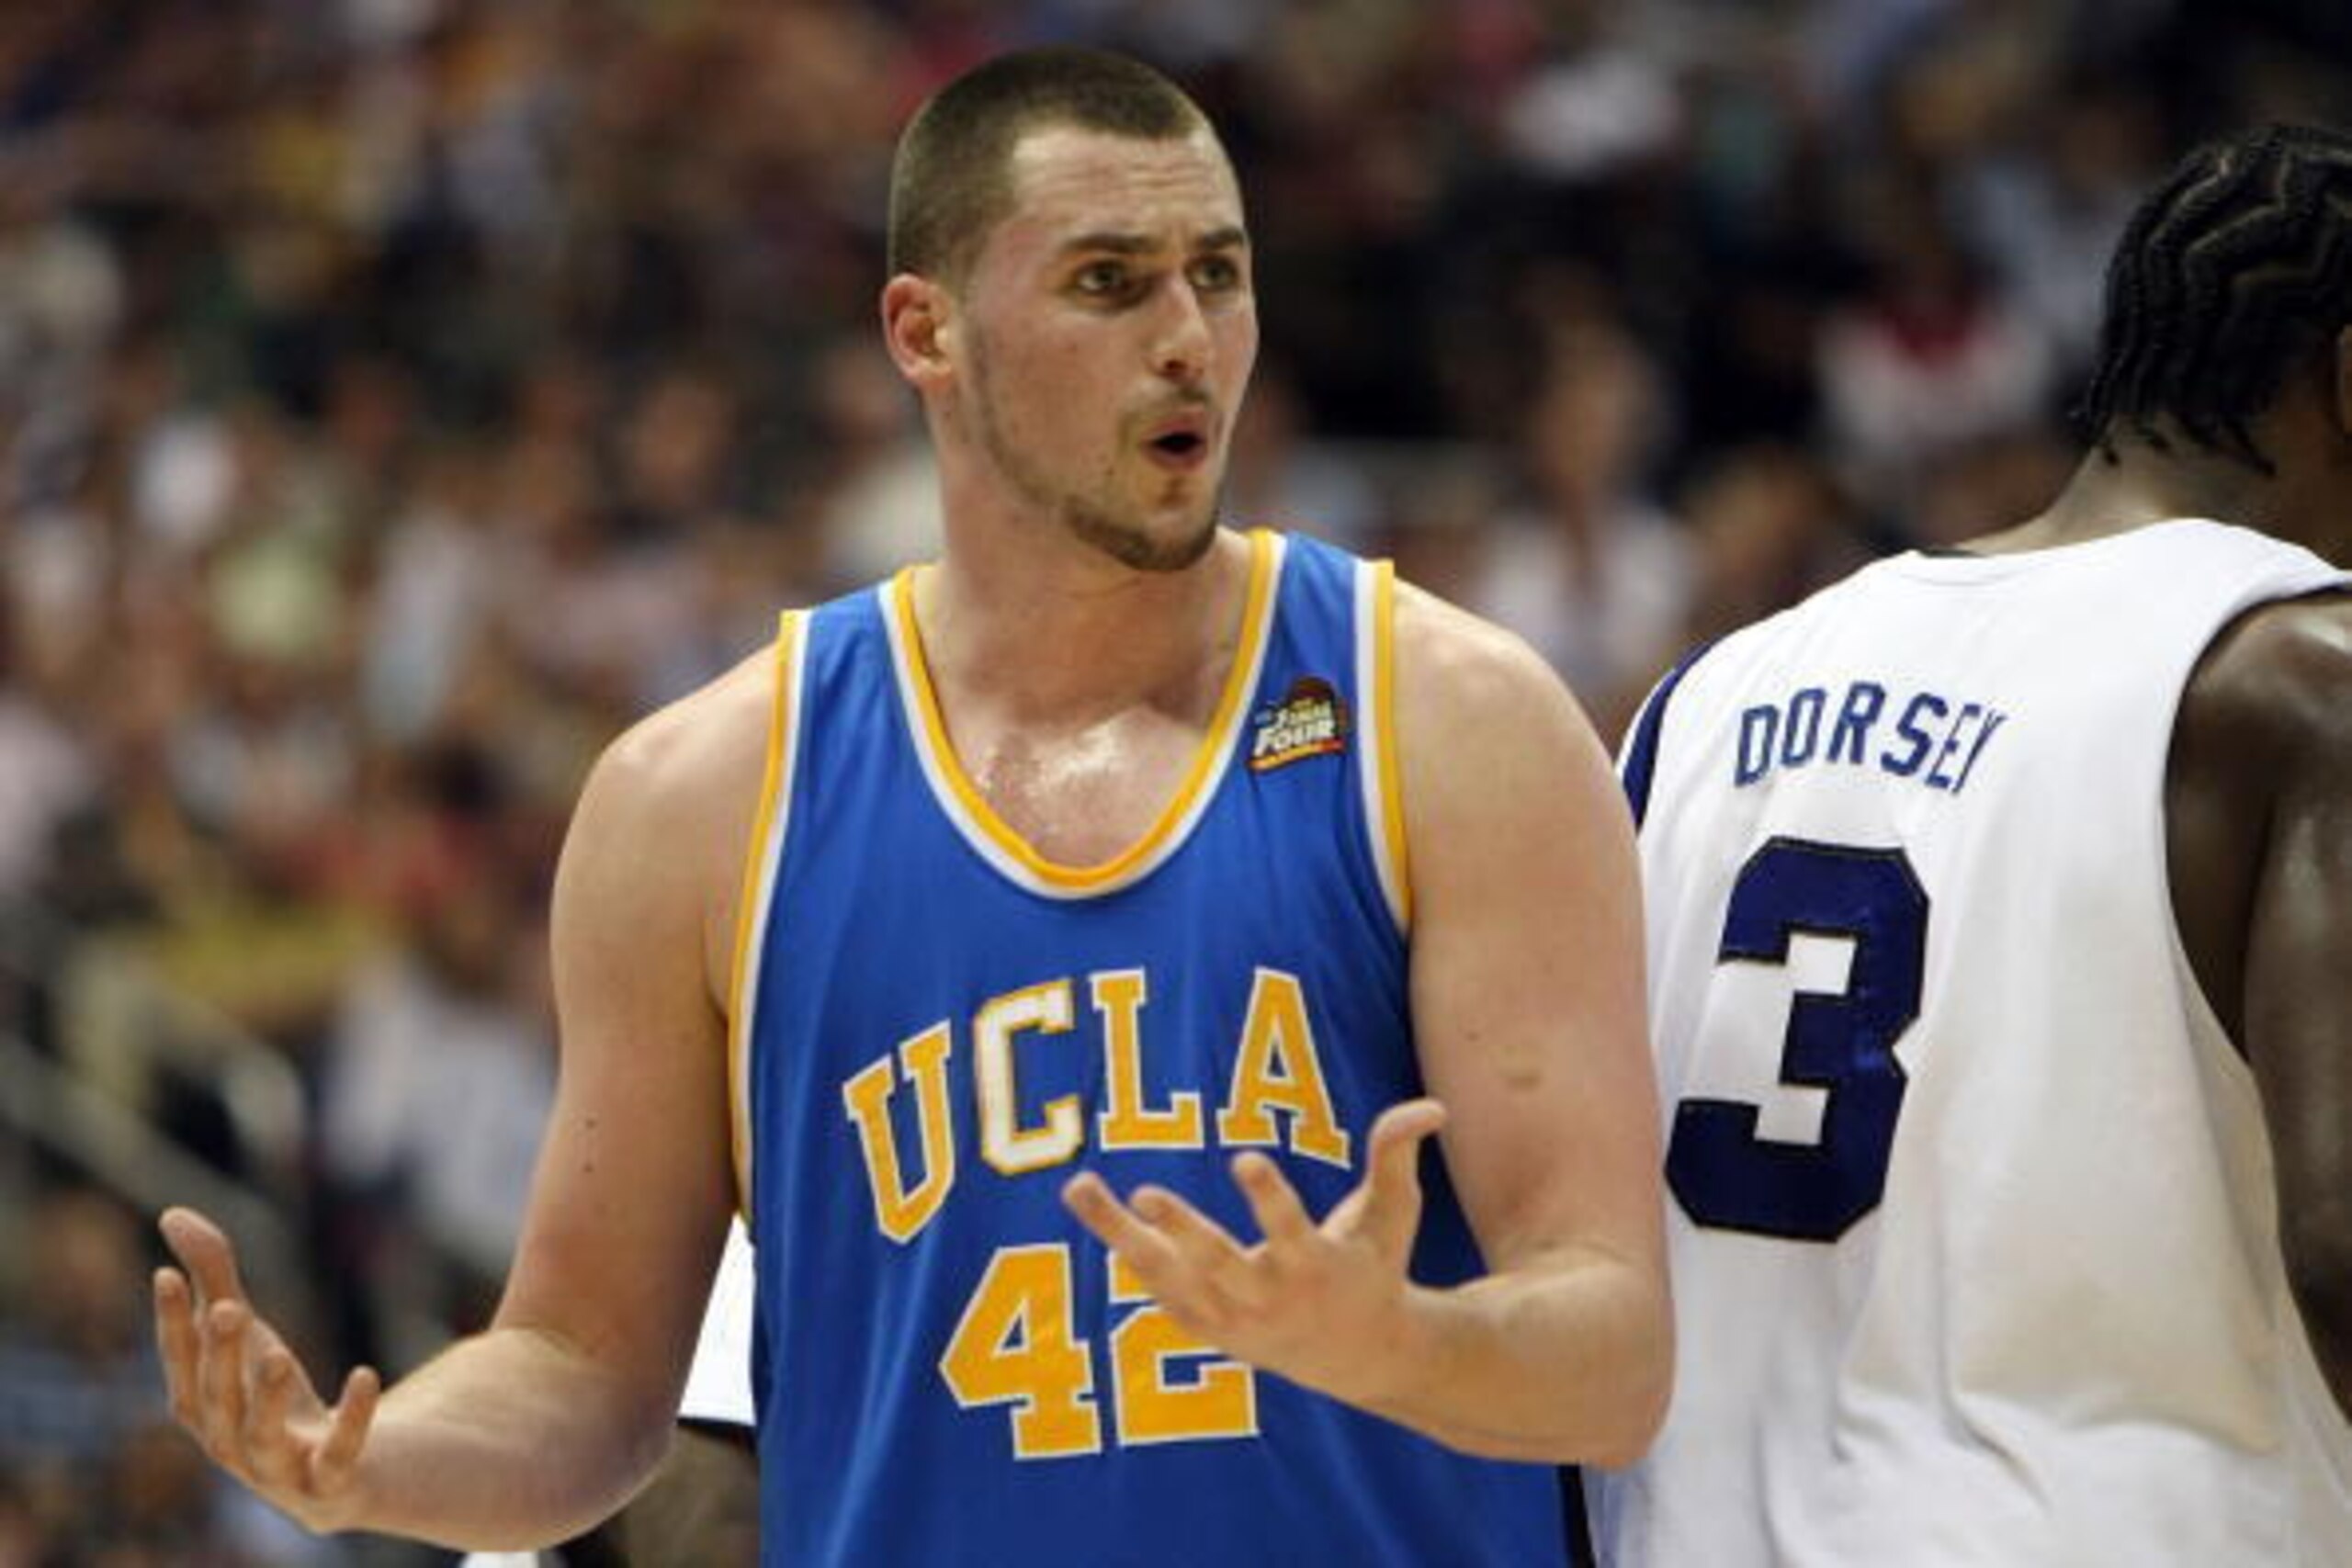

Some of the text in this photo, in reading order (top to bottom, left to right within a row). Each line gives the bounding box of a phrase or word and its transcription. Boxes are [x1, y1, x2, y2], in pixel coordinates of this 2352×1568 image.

[1253, 719, 1337, 757] FOUR
[1735, 681, 2007, 794] DORSEY
[842, 965, 1351, 1245] UCLA
[1664, 835, 1930, 1244] 3
[938, 1243, 1259, 1460] 42
